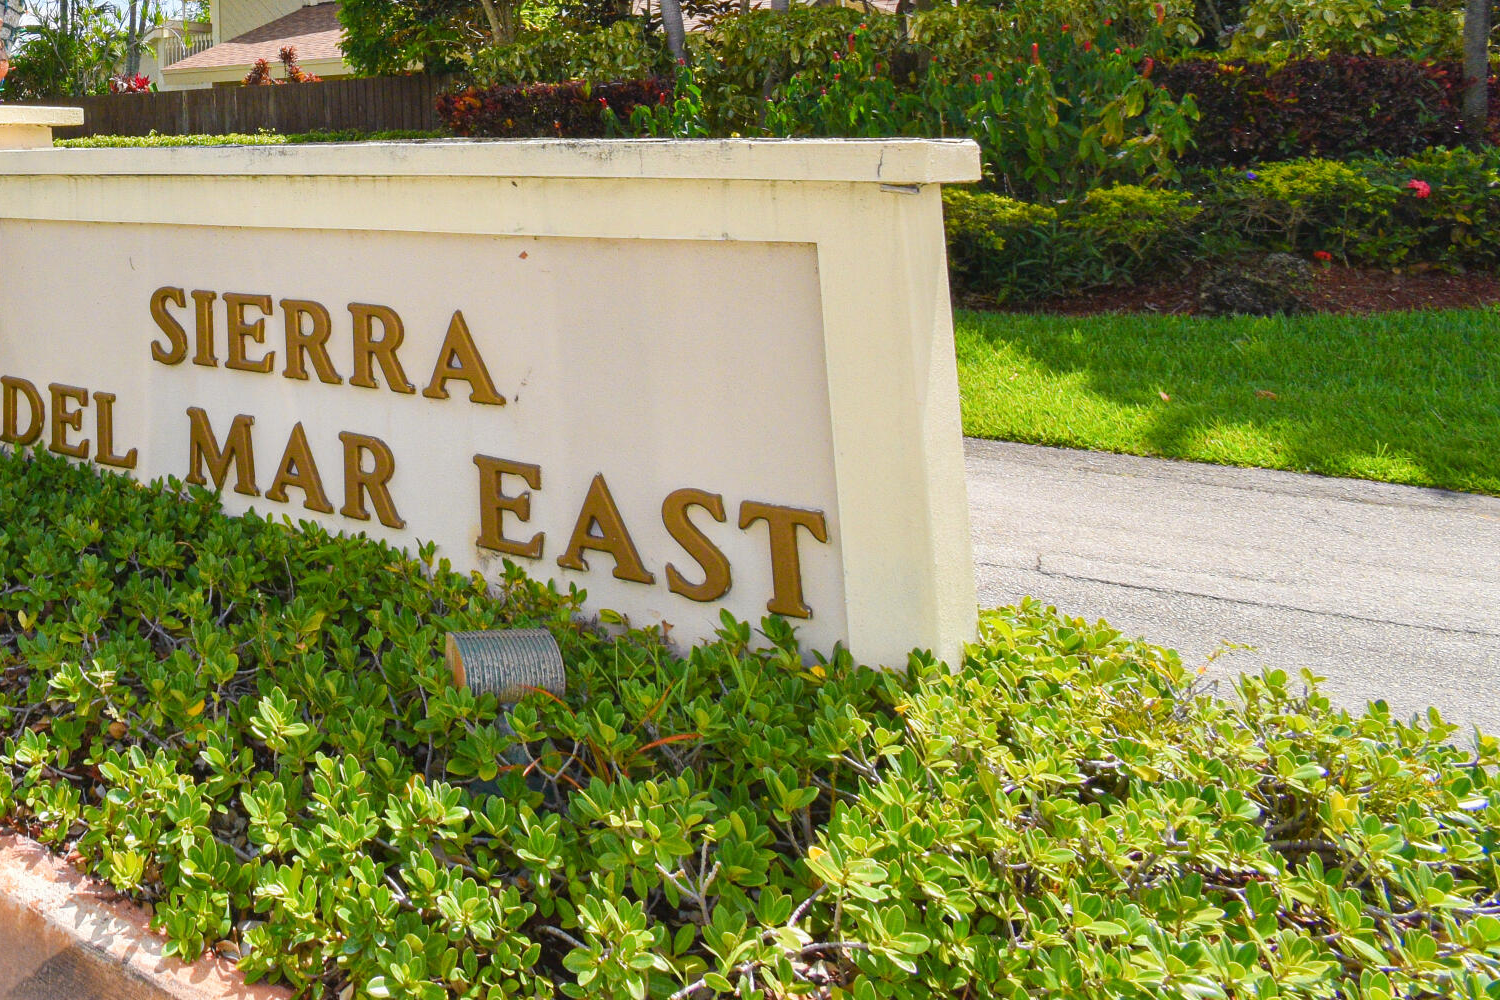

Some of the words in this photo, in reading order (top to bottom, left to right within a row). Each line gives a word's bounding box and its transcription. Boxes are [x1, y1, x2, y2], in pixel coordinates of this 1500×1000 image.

[150, 285, 506, 406] SIERRA
[186, 406, 407, 529] MAR
[473, 453, 828, 619] EAST
